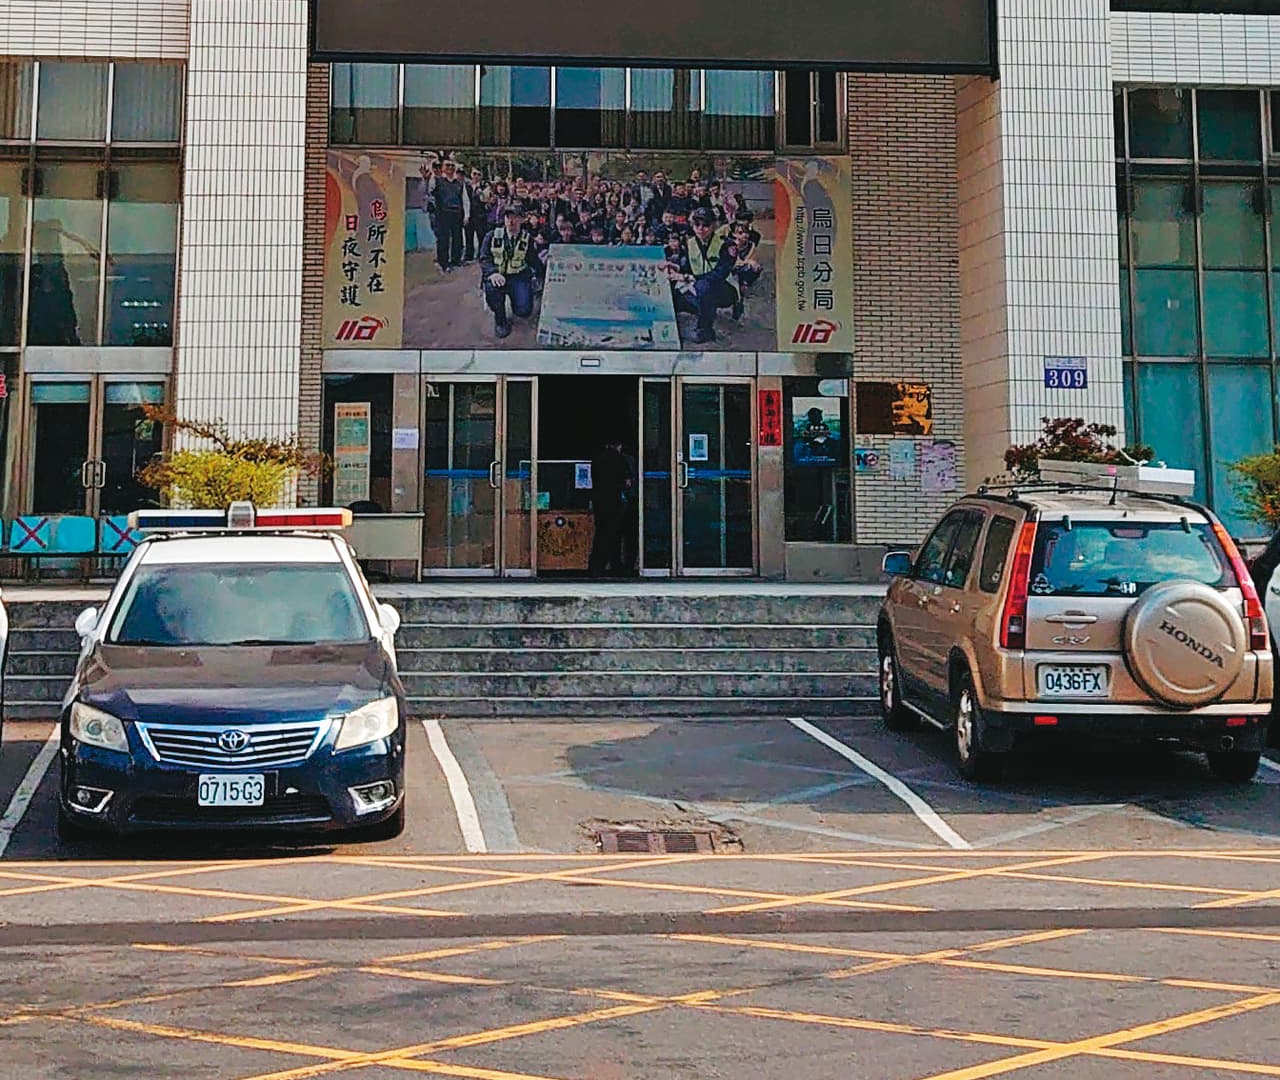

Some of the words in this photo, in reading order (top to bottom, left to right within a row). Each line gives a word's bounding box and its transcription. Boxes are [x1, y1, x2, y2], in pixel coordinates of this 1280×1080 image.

[340, 215, 361, 307] 日夜守護
[812, 207, 834, 311] 烏日分局
[1049, 369, 1084, 387] 309
[1159, 620, 1225, 669] HONDA
